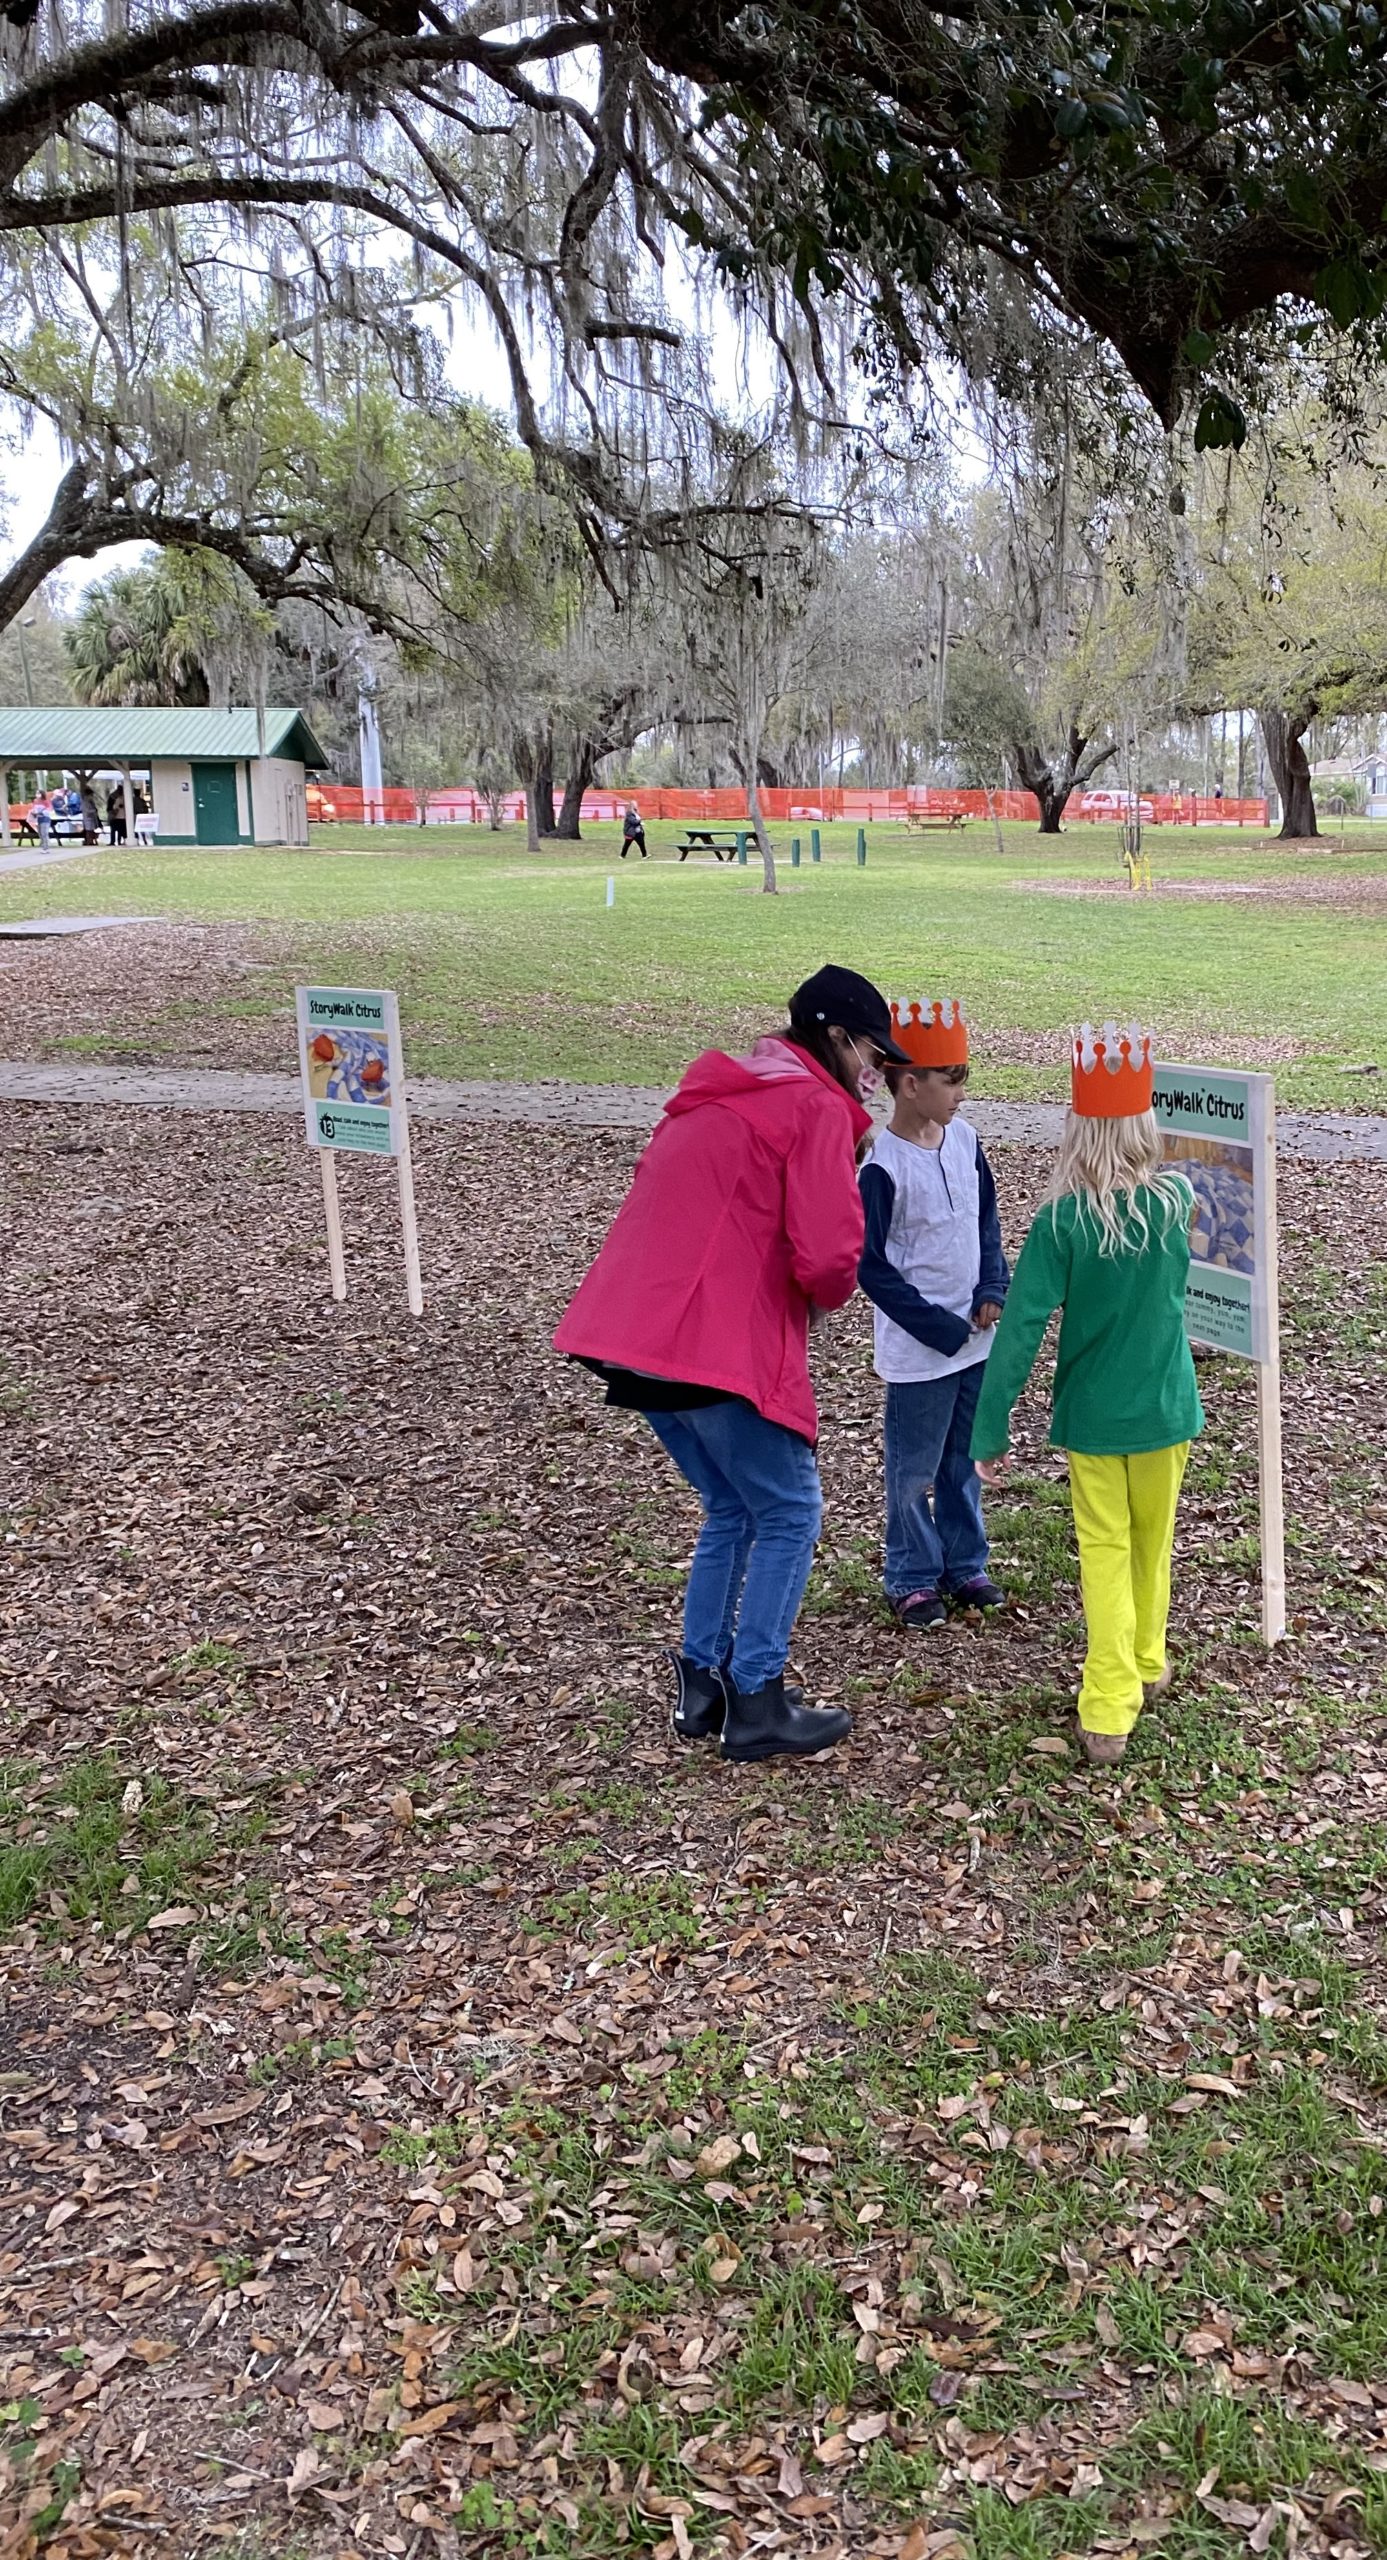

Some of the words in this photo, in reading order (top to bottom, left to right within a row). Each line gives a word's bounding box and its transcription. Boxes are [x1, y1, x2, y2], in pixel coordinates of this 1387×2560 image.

[310, 1000, 354, 1019] StoryWalk
[356, 1003, 381, 1018] Citrus
[1152, 1089, 1204, 1117] oryWalk
[1207, 1093, 1244, 1120] Citrus
[322, 1119, 333, 1137] 13
[1193, 1288, 1204, 1299] and
[1205, 1292, 1221, 1307] enjoy
